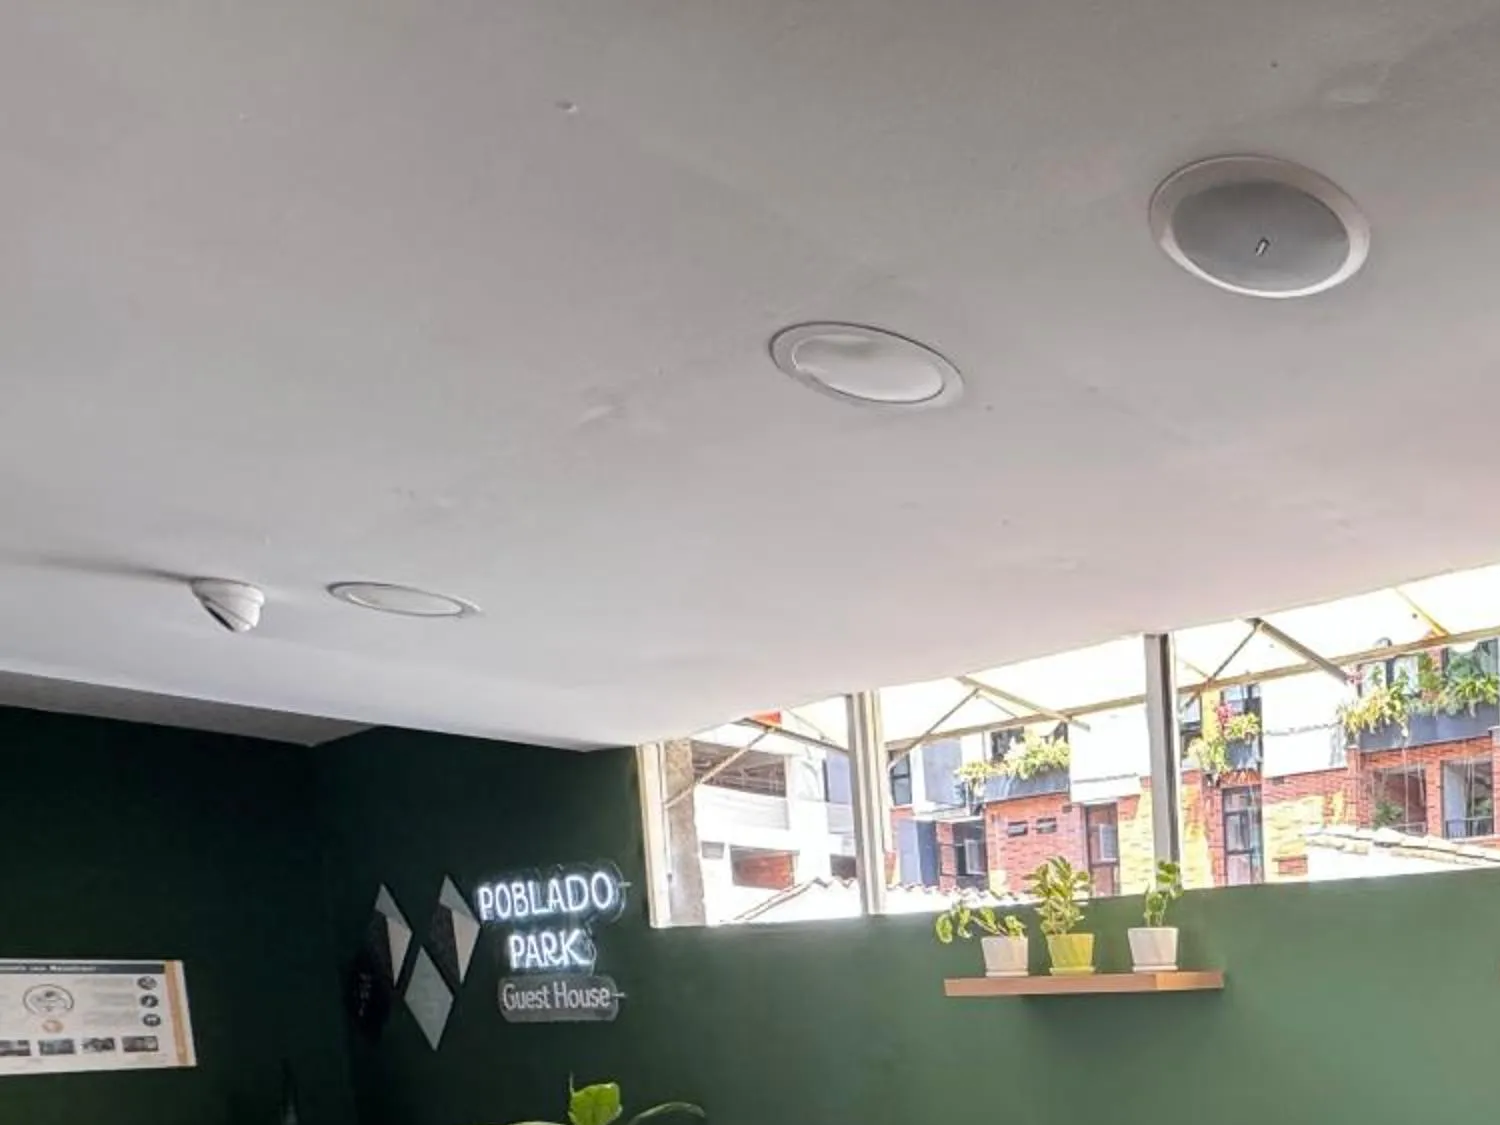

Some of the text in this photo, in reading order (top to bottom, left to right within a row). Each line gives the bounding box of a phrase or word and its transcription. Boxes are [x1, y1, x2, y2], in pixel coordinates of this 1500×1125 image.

[477, 871, 613, 920] POBLADO
[509, 928, 592, 969] PARK
[503, 981, 611, 1010] Guest House
